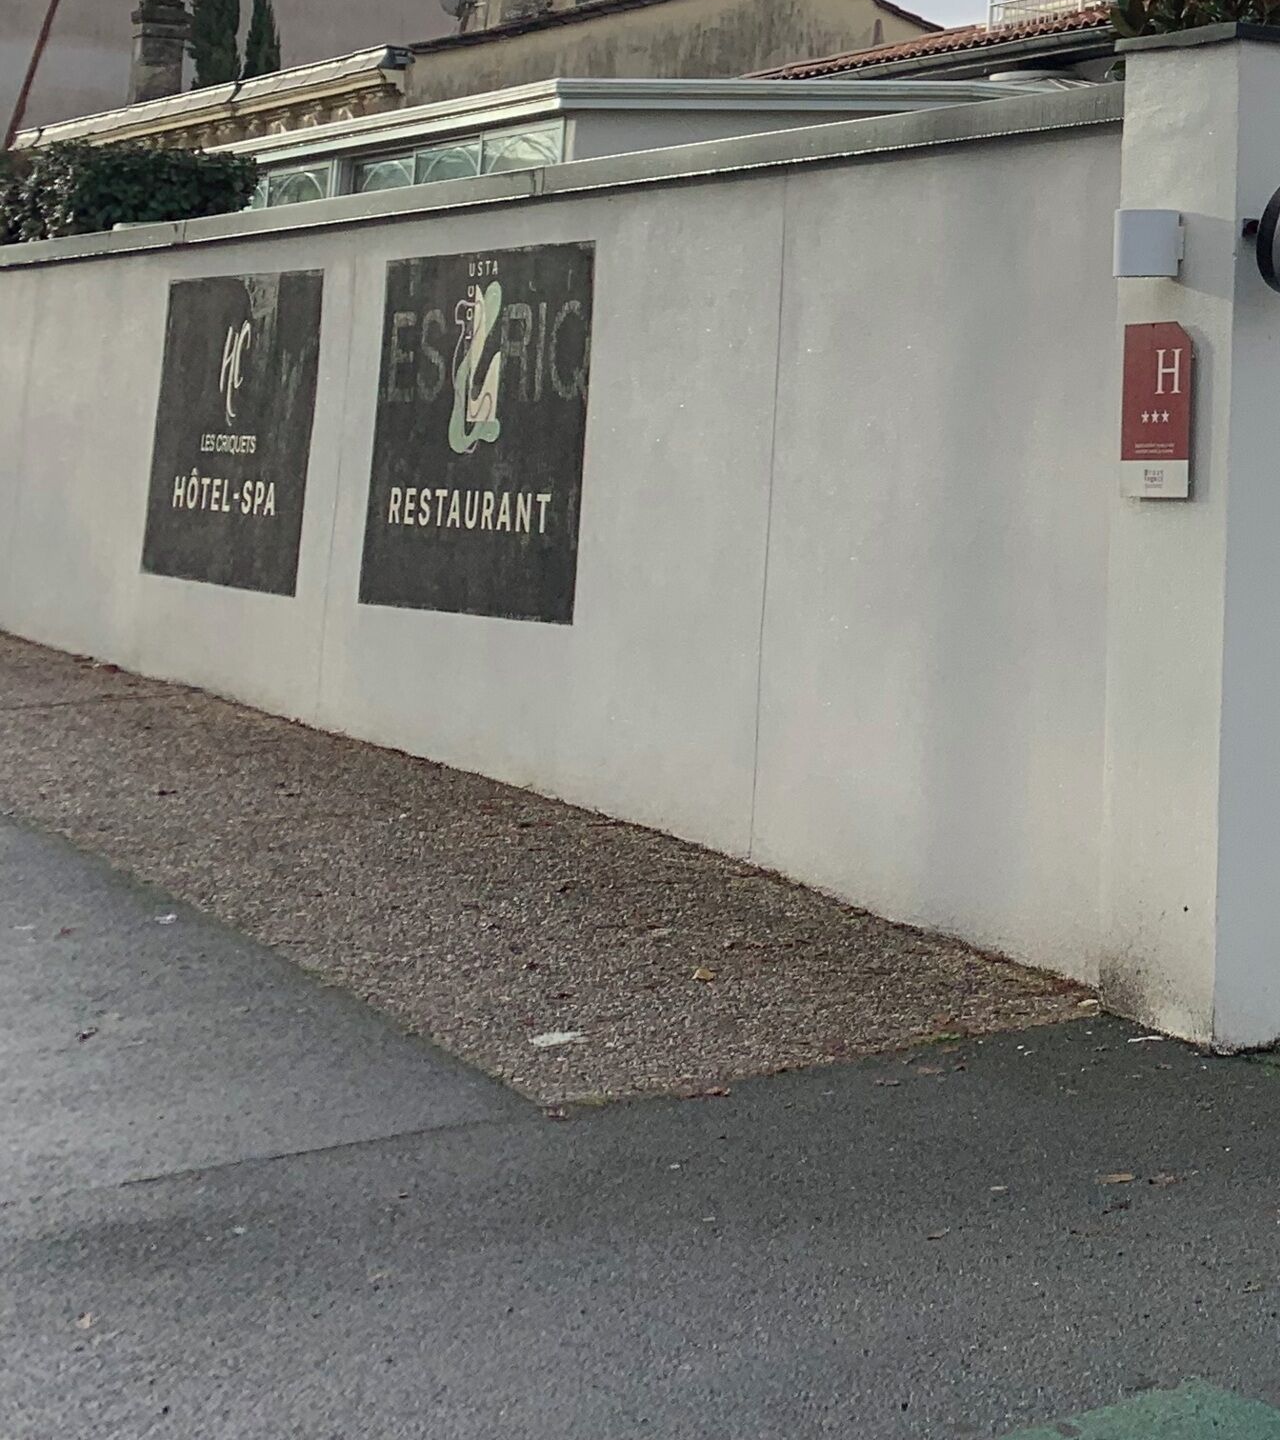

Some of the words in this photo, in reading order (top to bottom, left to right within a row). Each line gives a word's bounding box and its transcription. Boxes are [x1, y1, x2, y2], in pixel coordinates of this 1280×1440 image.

[468, 260, 499, 277] USTA
[1154, 348, 1183, 395] H
[200, 433, 215, 452] LES
[216, 433, 257, 455] CRIQUETS
[172, 466, 276, 516] HÔTEL-SPA
[388, 486, 552, 534] RESTAURANT
